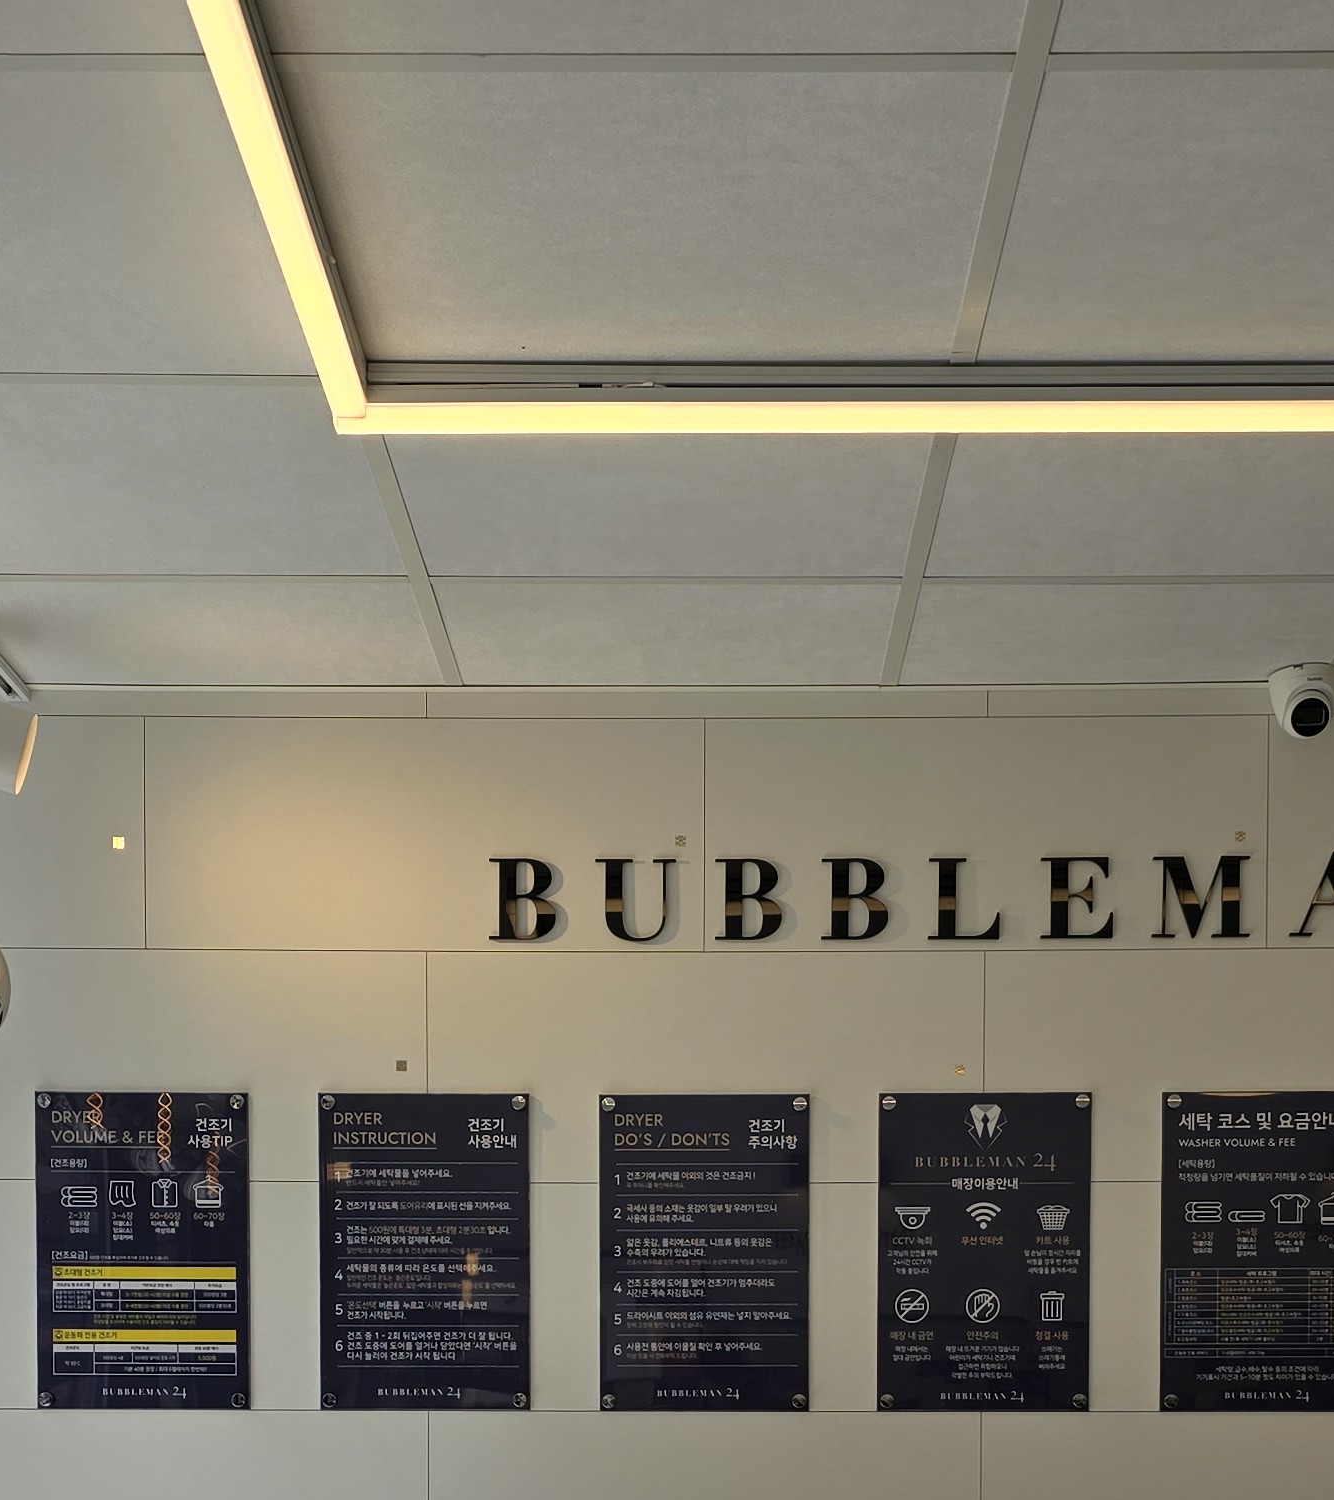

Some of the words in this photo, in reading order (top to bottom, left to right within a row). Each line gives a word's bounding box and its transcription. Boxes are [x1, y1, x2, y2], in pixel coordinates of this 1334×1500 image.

[51, 1110, 100, 1124] DRYER
[333, 1112, 382, 1126] DRYER
[614, 1113, 663, 1127] DRYER
[1178, 1112, 1212, 1130] 세탁
[1217, 1112, 1250, 1129] 코스
[1256, 1112, 1271, 1130] 및
[195, 1117, 233, 1132] 건조기
[467, 1117, 505, 1132] 건조기
[748, 1118, 785, 1132] 건조기
[51, 1130, 116, 1144] VOLUME
[122, 1130, 133, 1144] &
[187, 1134, 233, 1148] 사용TIP
[333, 1131, 436, 1146] INSTRUCTION
[467, 1134, 517, 1149] 사용안내
[614, 1132, 652, 1146] DO'S
[671, 1132, 730, 1146] DON'TS
[748, 1135, 798, 1149] 주의사항
[1178, 1138, 1221, 1147] WASHER
[1224, 1138, 1265, 1147] VOLUME
[1268, 1138, 1276, 1147] &
[1279, 1138, 1295, 1147] FEE
[914, 1156, 1026, 1168] BUBBLEMAN
[1032, 1152, 1056, 1171] 24
[614, 1174, 621, 1185] 1
[951, 1177, 1018, 1190] 매장이용안내
[334, 1199, 342, 1211] 2
[613, 1207, 621, 1219] 2
[334, 1232, 342, 1244] 3
[892, 1236, 915, 1245] CCTV
[1054, 1236, 1069, 1245] 사용
[613, 1245, 621, 1257] 3
[334, 1269, 343, 1280] 4
[613, 1281, 622, 1293] 4
[335, 1304, 343, 1315] 5
[614, 1313, 622, 1325] 5
[335, 1341, 343, 1351] 6
[613, 1343, 622, 1355] 6
[102, 1387, 169, 1396] BUBBLEMAN
[172, 1386, 187, 1399] 24
[377, 1387, 444, 1396] BUBBLEMAN
[446, 1386, 461, 1399] 24
[657, 1388, 722, 1397] BUBBLEMAN
[725, 1387, 740, 1400] 24
[940, 1391, 1006, 1400] BUBBLEMAN
[1010, 1390, 1024, 1403] 24
[1224, 1391, 1292, 1400] BUBBLEMAN
[1295, 1390, 1310, 1402] 24
